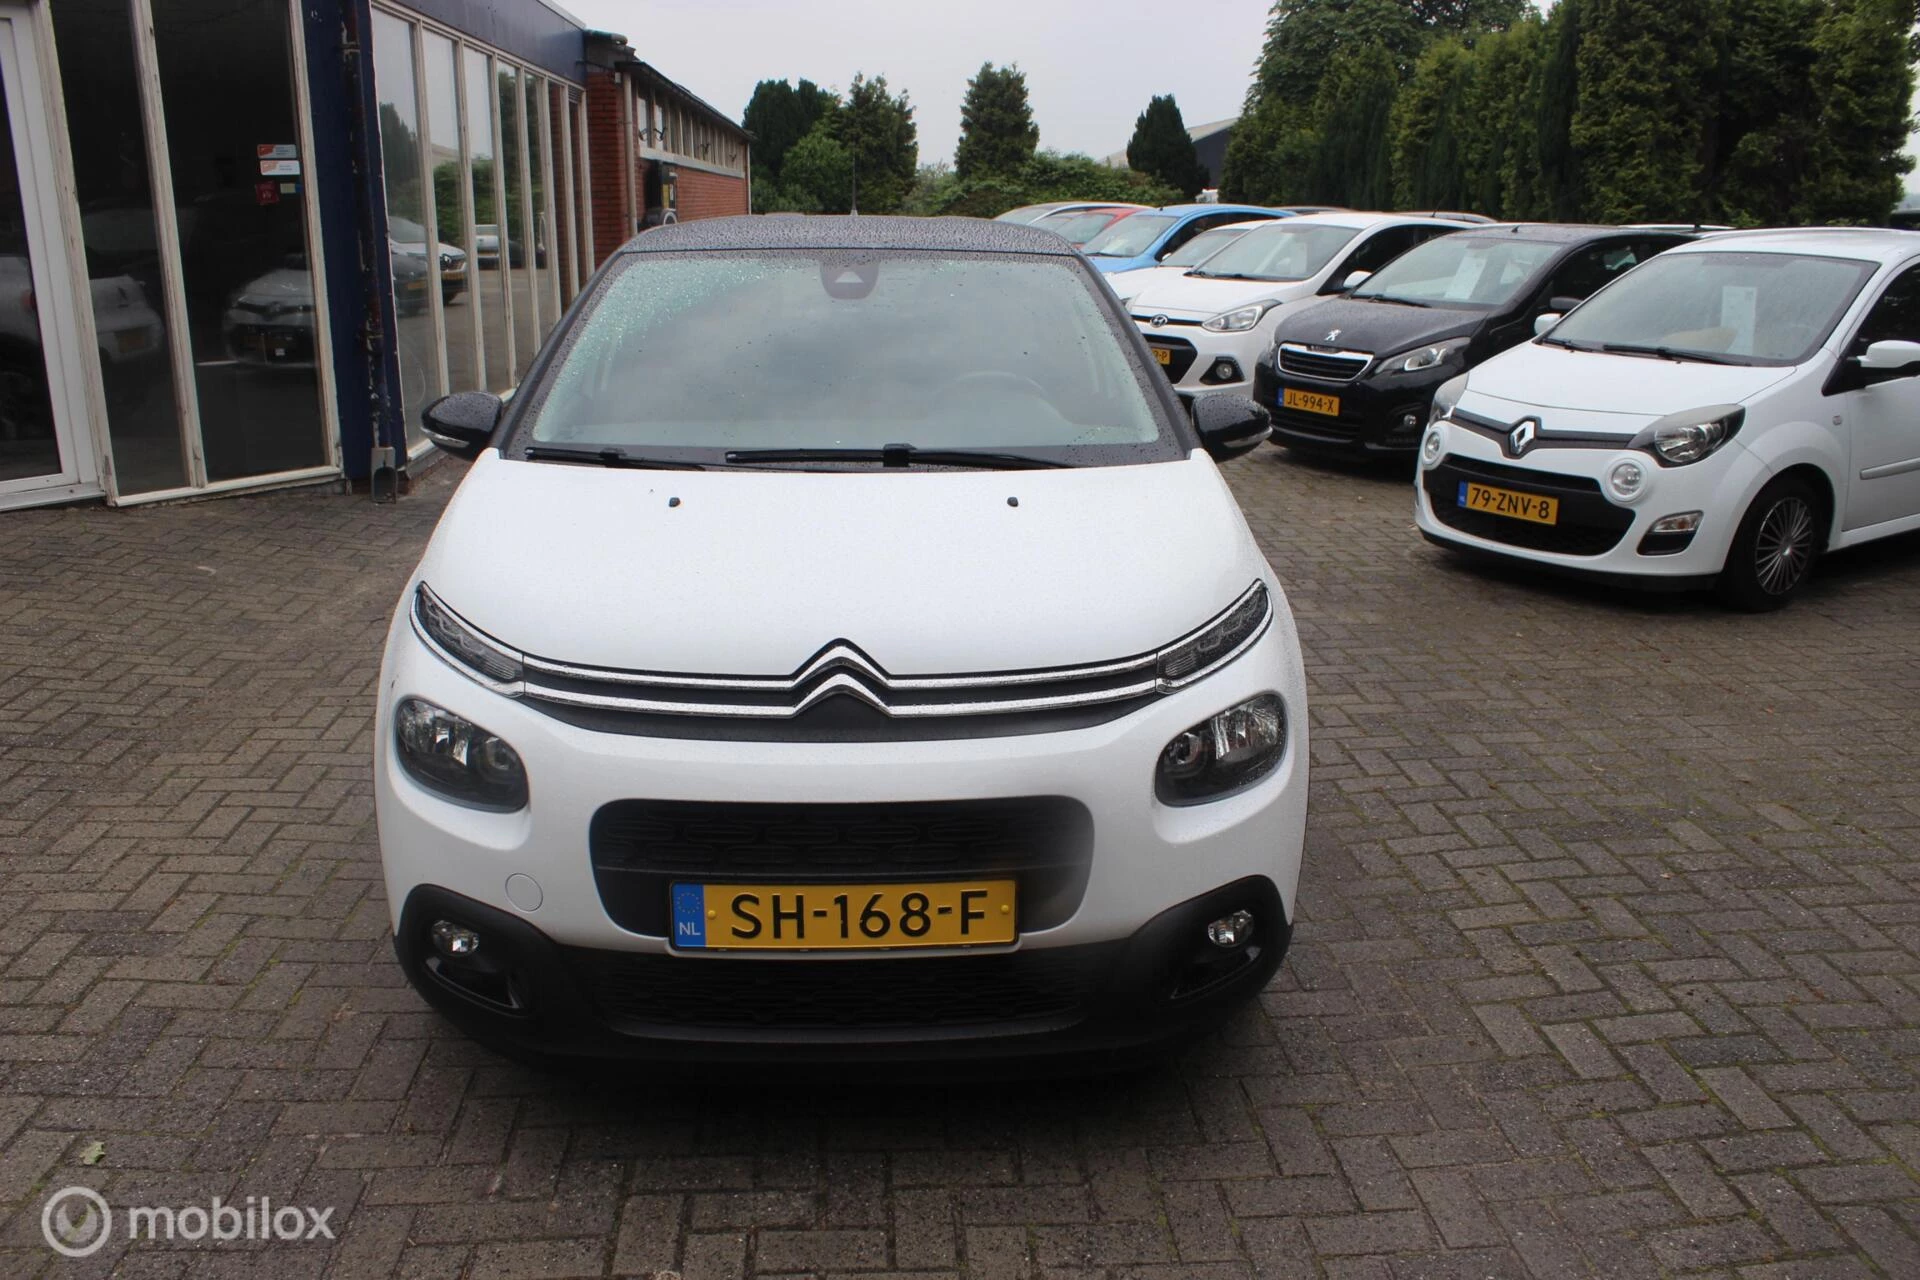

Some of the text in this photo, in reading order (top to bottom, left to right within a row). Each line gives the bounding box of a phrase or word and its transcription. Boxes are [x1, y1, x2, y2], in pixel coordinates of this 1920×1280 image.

[1287, 391, 1335, 413] JL-994-X
[1472, 487, 1550, 519] 79-ZNV-8
[679, 889, 988, 939] NL SH-168-F
